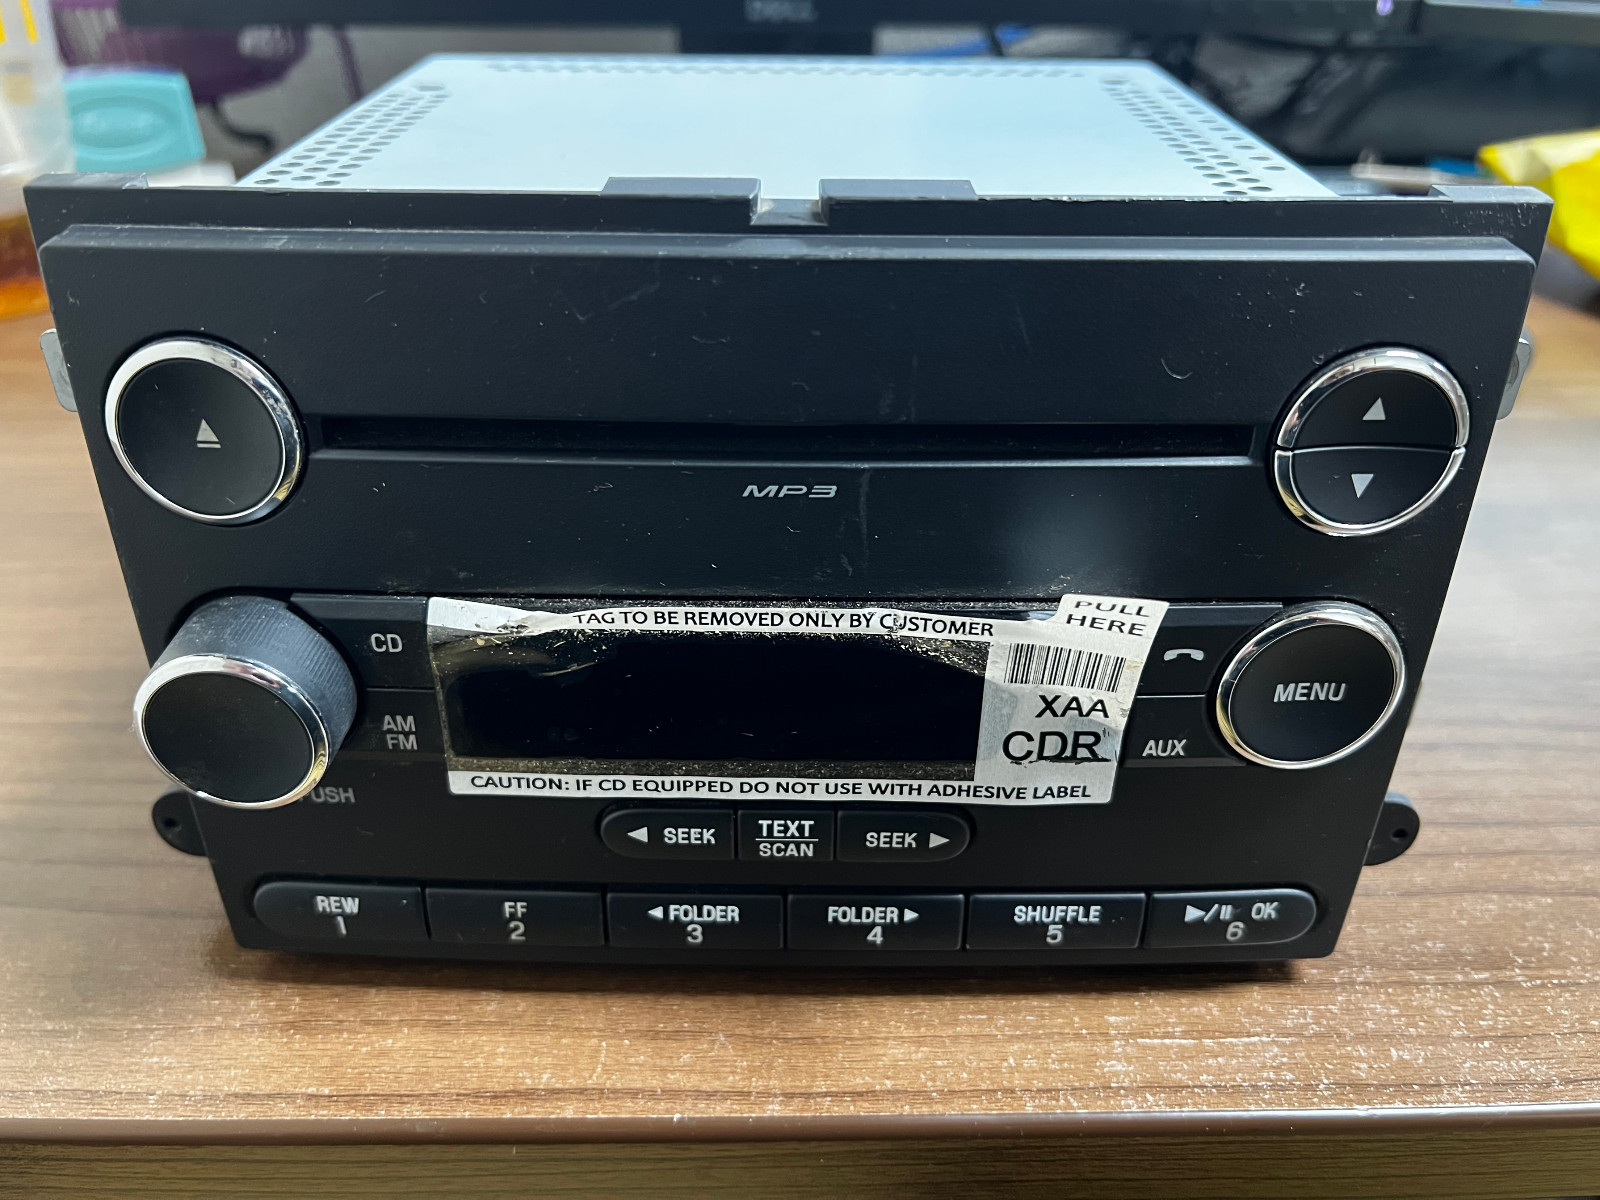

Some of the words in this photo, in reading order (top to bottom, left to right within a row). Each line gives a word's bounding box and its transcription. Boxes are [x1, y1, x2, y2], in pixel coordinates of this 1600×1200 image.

[742, 485, 837, 498] MP3
[1075, 600, 1150, 618] PULL
[573, 611, 615, 625] TAG
[619, 611, 648, 625] TO
[653, 611, 679, 625] BE
[684, 611, 784, 627] REMOVED
[789, 612, 845, 628] ONLY
[849, 613, 874, 628] BY
[879, 613, 994, 637] CUSTOMER
[1066, 613, 1147, 636] HERE
[371, 633, 403, 653] CD
[1273, 682, 1346, 703] MENU
[1035, 694, 1110, 719] XAA
[382, 715, 416, 732] AM
[386, 734, 418, 750] FM
[1002, 730, 1103, 762] CDR
[1142, 739, 1187, 757] AUX
[301, 786, 356, 804] USH
[470, 775, 570, 791] CAUTION:
[575, 779, 593, 791] IF
[599, 778, 627, 792] CD
[632, 779, 734, 794] EQUIPPED
[739, 781, 770, 794] DO
[775, 781, 820, 795] NOT
[824, 782, 863, 795] USE
[867, 782, 922, 796] WITH
[926, 783, 1027, 800] ADHESIVE
[1032, 784, 1092, 799] LABEL
[663, 827, 716, 845] SEEK
[758, 820, 815, 837] TEXT
[865, 832, 917, 848] SEEK
[759, 843, 815, 858] SCAN
[316, 895, 360, 914] REW
[504, 901, 528, 919] FF
[669, 904, 740, 923] FOLDER
[1251, 902, 1279, 920] OK
[827, 906, 899, 924] FOLDER
[1013, 905, 1101, 924] SHUFFLE
[334, 915, 348, 937] 1
[509, 921, 526, 941] 2
[685, 924, 703, 944] 3
[866, 925, 884, 945] 4
[1045, 924, 1063, 944] 5
[1225, 921, 1244, 942] 6
